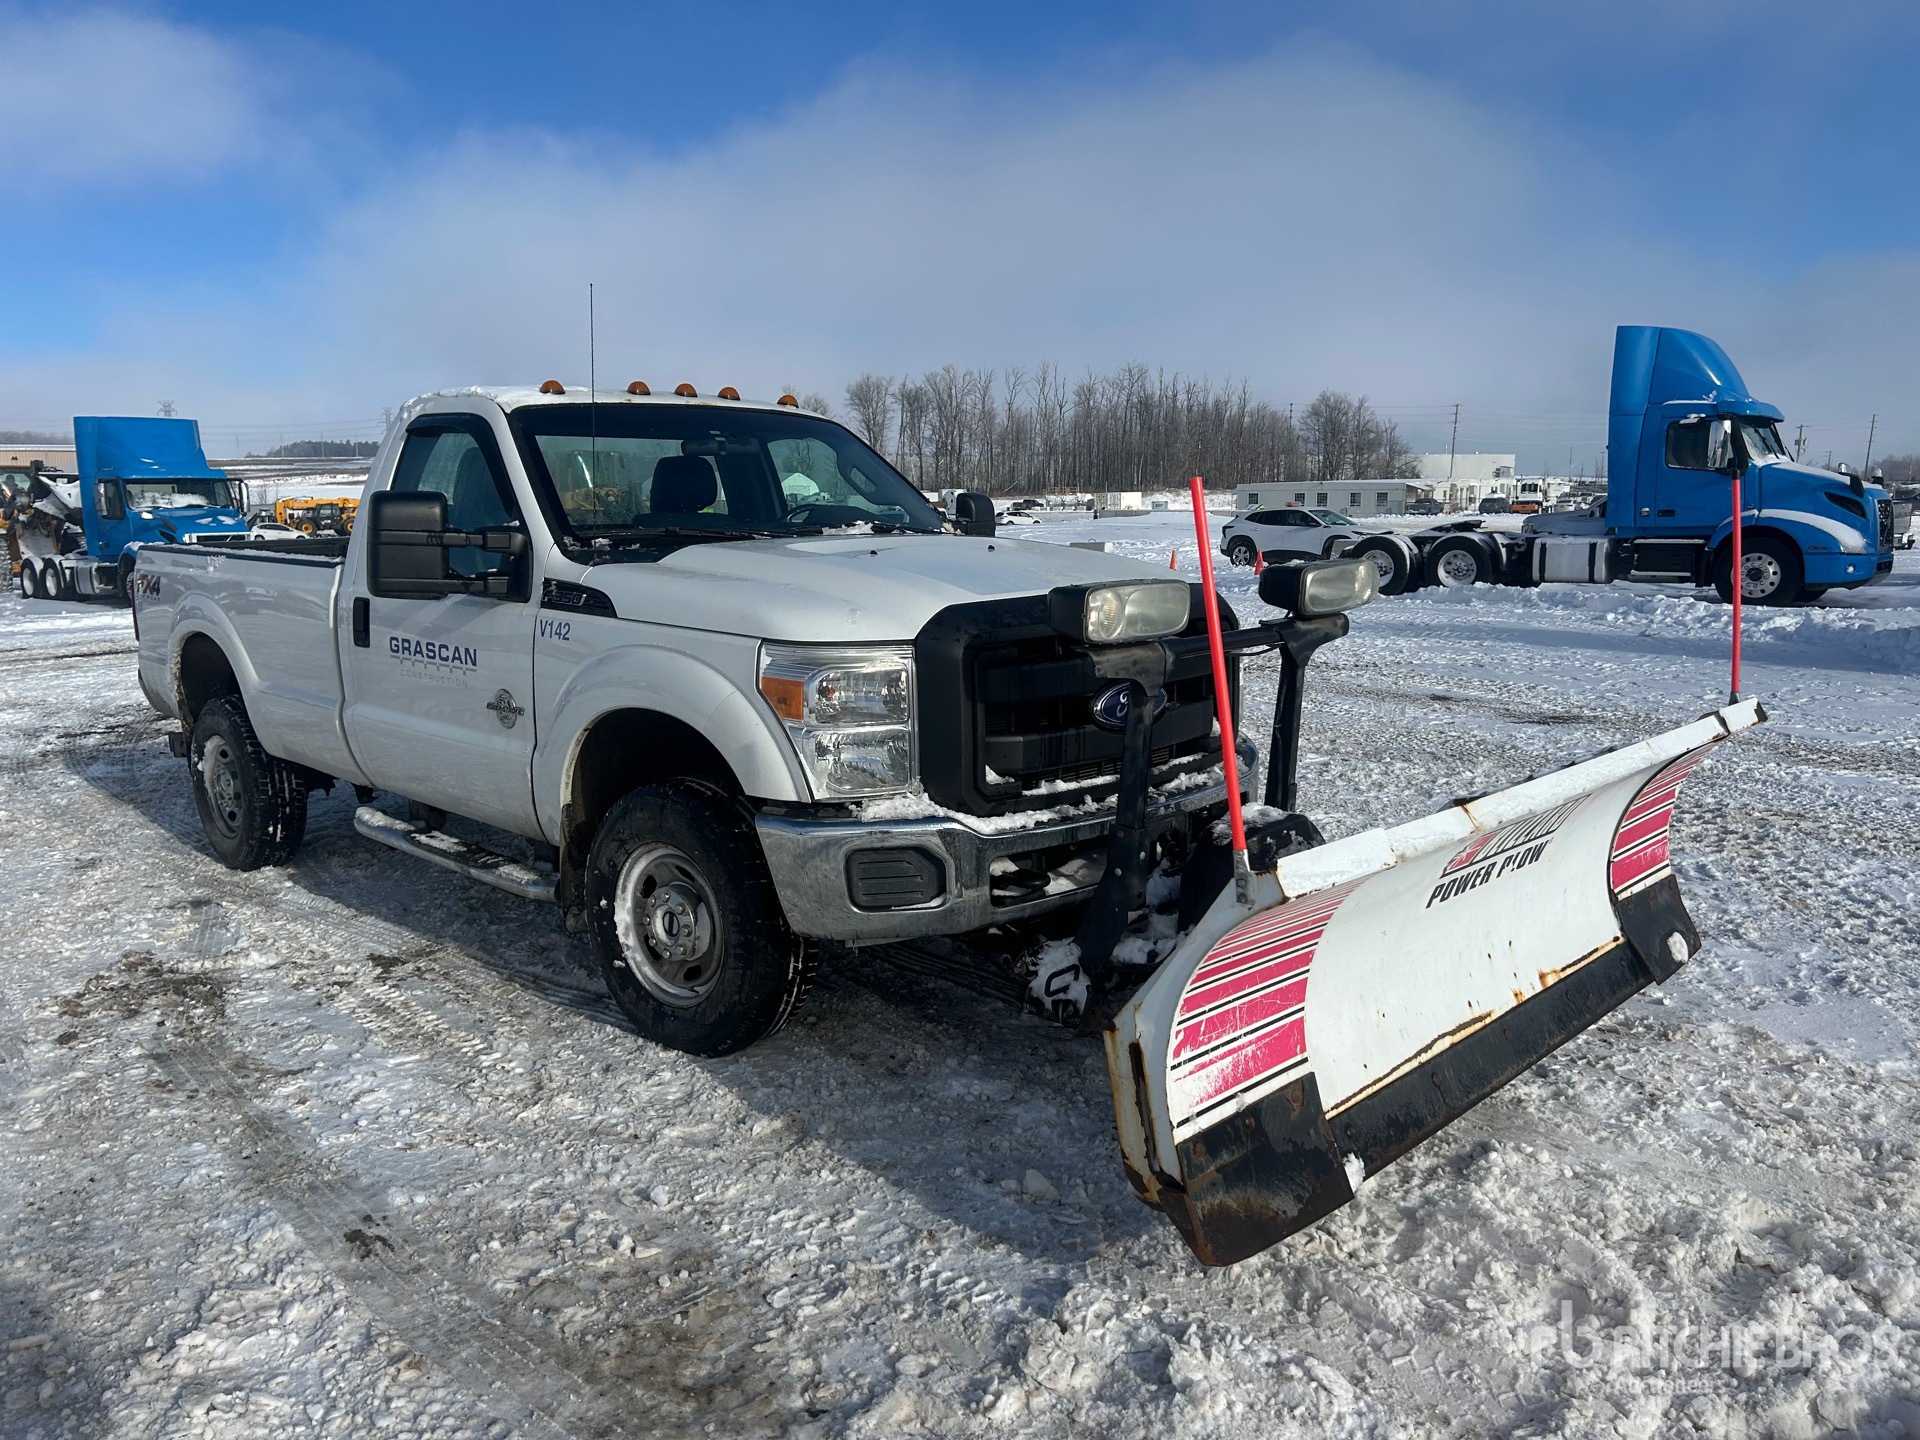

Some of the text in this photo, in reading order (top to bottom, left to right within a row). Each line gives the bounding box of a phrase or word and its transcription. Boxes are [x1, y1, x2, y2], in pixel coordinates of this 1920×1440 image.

[136, 573, 161, 596] FX4
[540, 619, 571, 641] V142
[389, 636, 477, 667] GRASCAN
[400, 668, 468, 688] CONSTRUCTION
[1425, 839, 1550, 909] POWER PLOW
